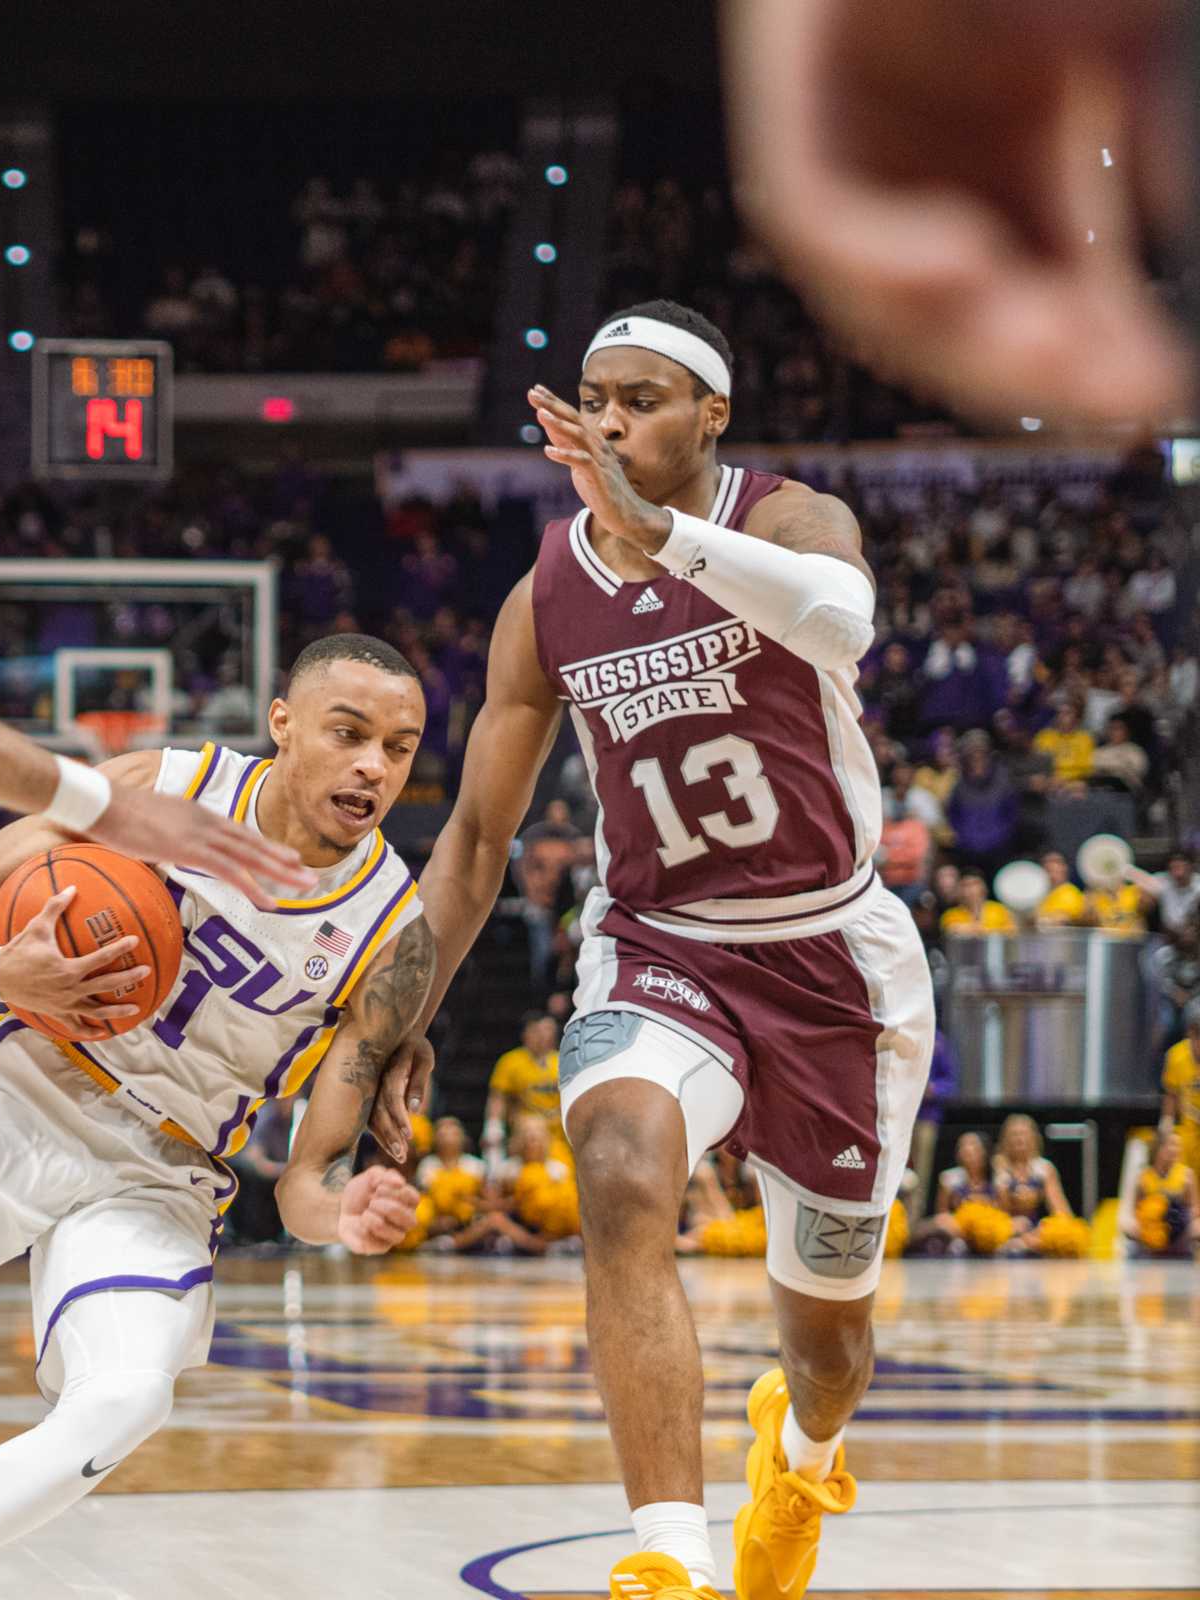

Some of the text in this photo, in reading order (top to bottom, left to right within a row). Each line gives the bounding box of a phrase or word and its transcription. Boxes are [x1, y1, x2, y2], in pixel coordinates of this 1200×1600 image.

[632, 600, 664, 614] adidas
[561, 622, 760, 702] MISSISSIPPI
[622, 687, 718, 730] STATE
[630, 734, 780, 869] 13
[152, 969, 213, 1050] 1
[651, 978, 698, 1006] STATE
[832, 1158, 866, 1170] adidas
